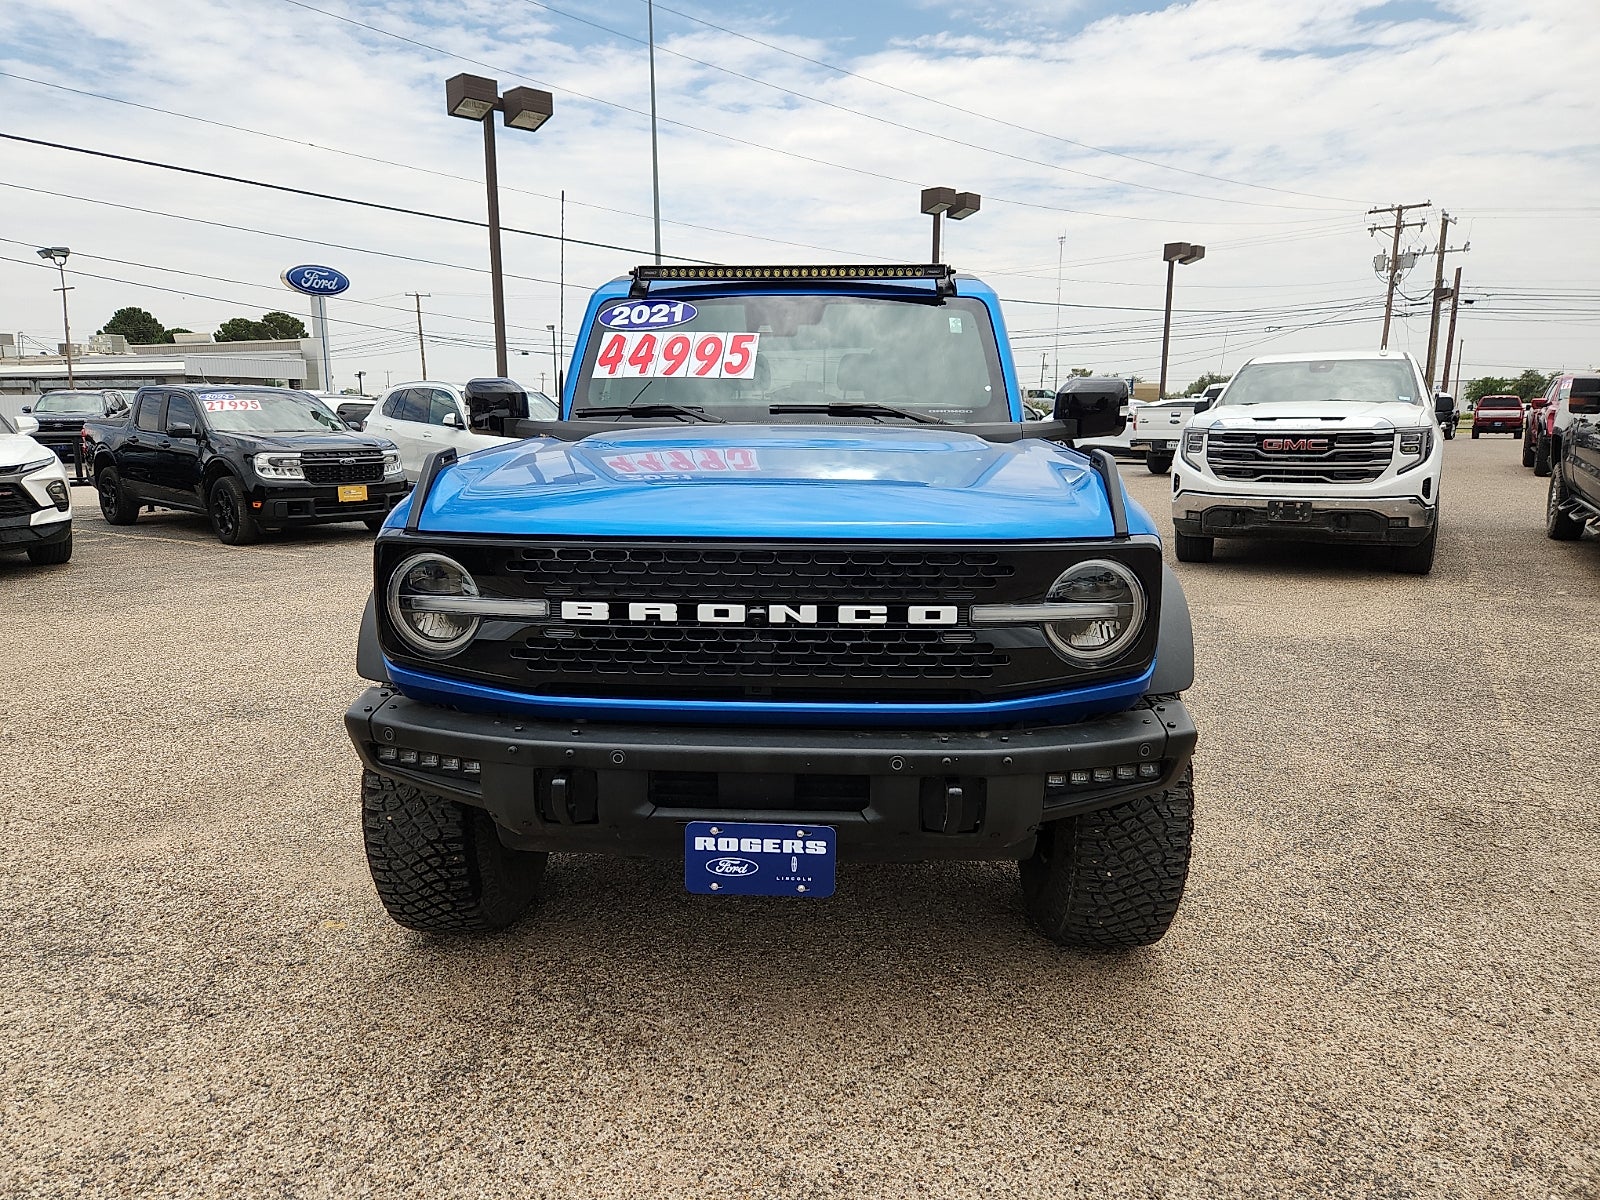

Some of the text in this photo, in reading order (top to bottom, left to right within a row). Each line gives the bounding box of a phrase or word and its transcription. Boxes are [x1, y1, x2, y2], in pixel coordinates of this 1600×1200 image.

[301, 269, 338, 290] Ford
[609, 303, 685, 326] 2021
[597, 333, 758, 377] 44995
[206, 400, 259, 411] 27995
[1262, 438, 1329, 451] GMC
[561, 601, 958, 626] BRONCO
[694, 836, 827, 855] ROGERS
[715, 859, 749, 874] Ford
